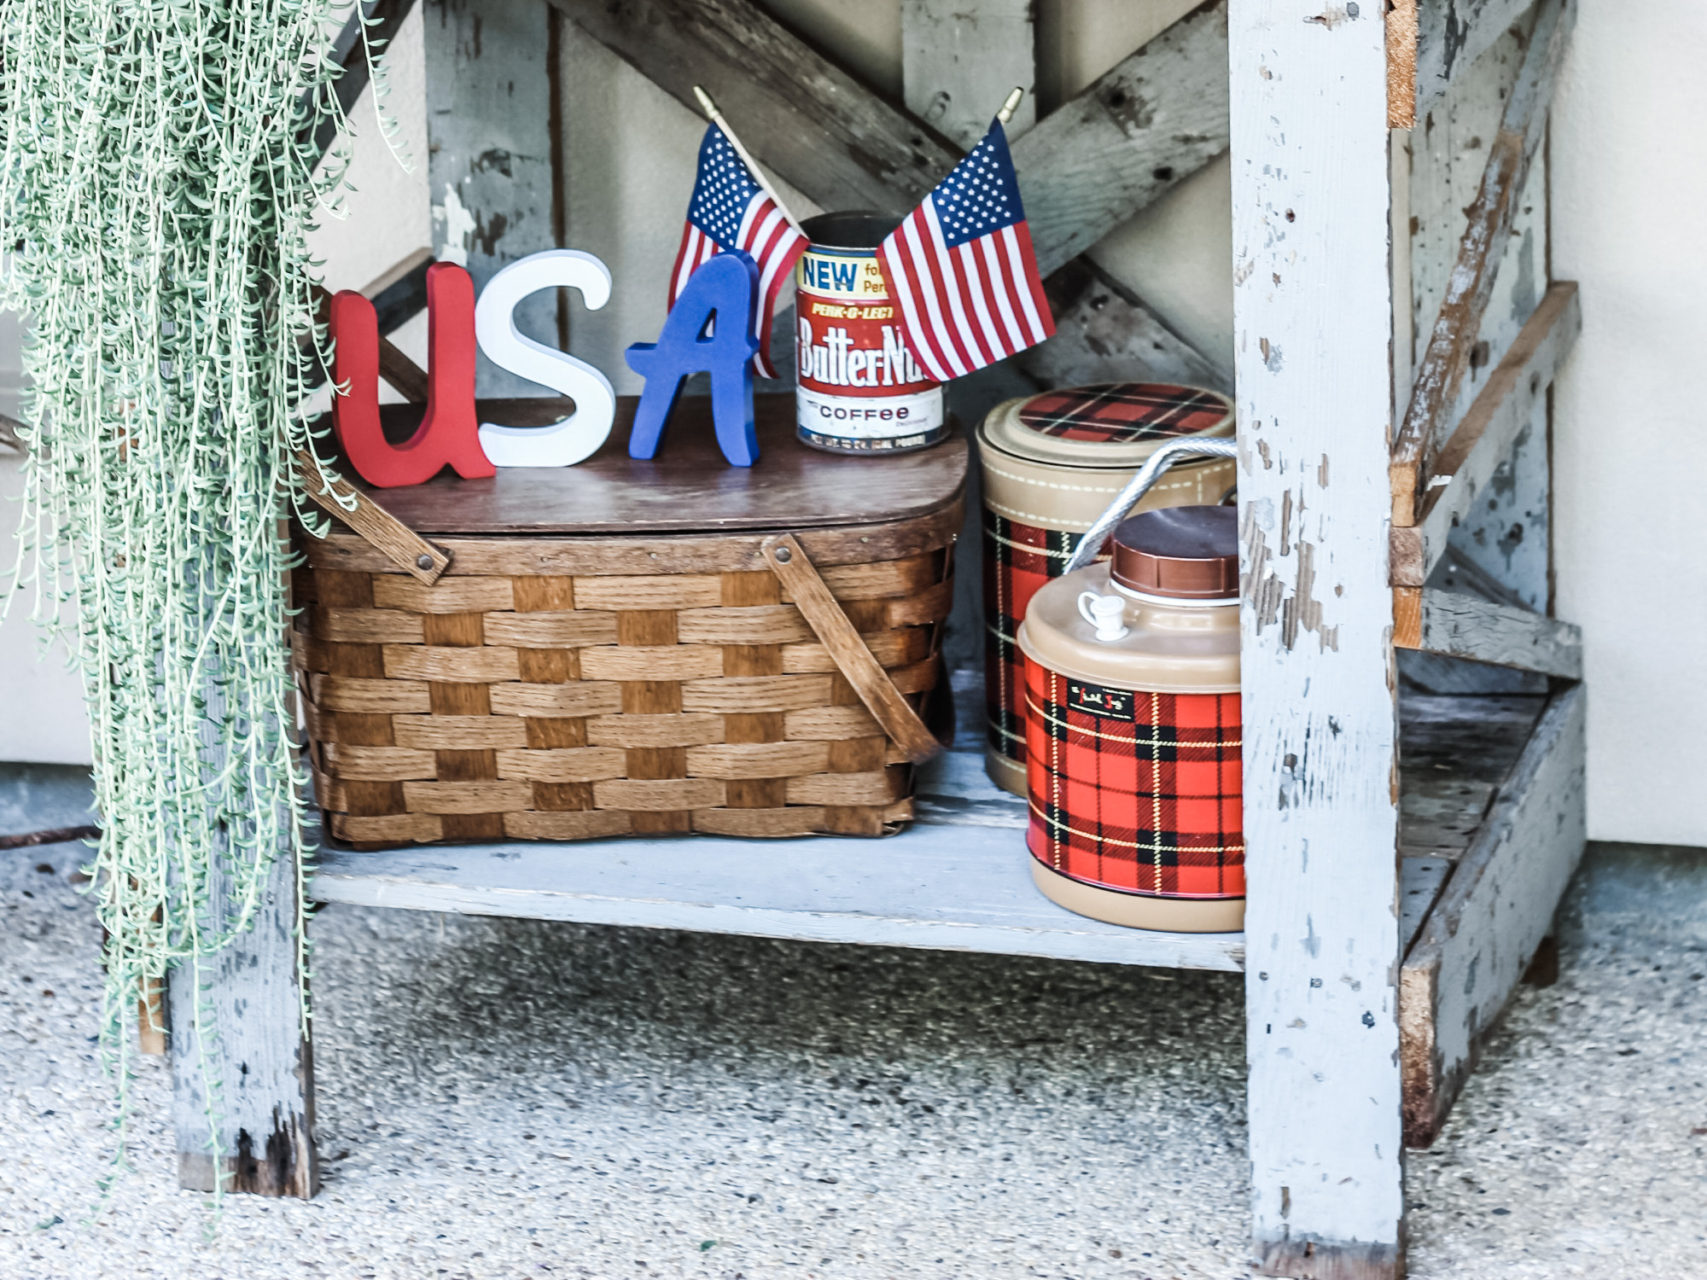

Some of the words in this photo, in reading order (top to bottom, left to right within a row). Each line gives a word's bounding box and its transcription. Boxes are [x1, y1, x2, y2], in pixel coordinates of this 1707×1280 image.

[803, 256, 858, 292] NEW
[864, 263, 881, 276] fo
[799, 316, 928, 388] Butter-Nu
